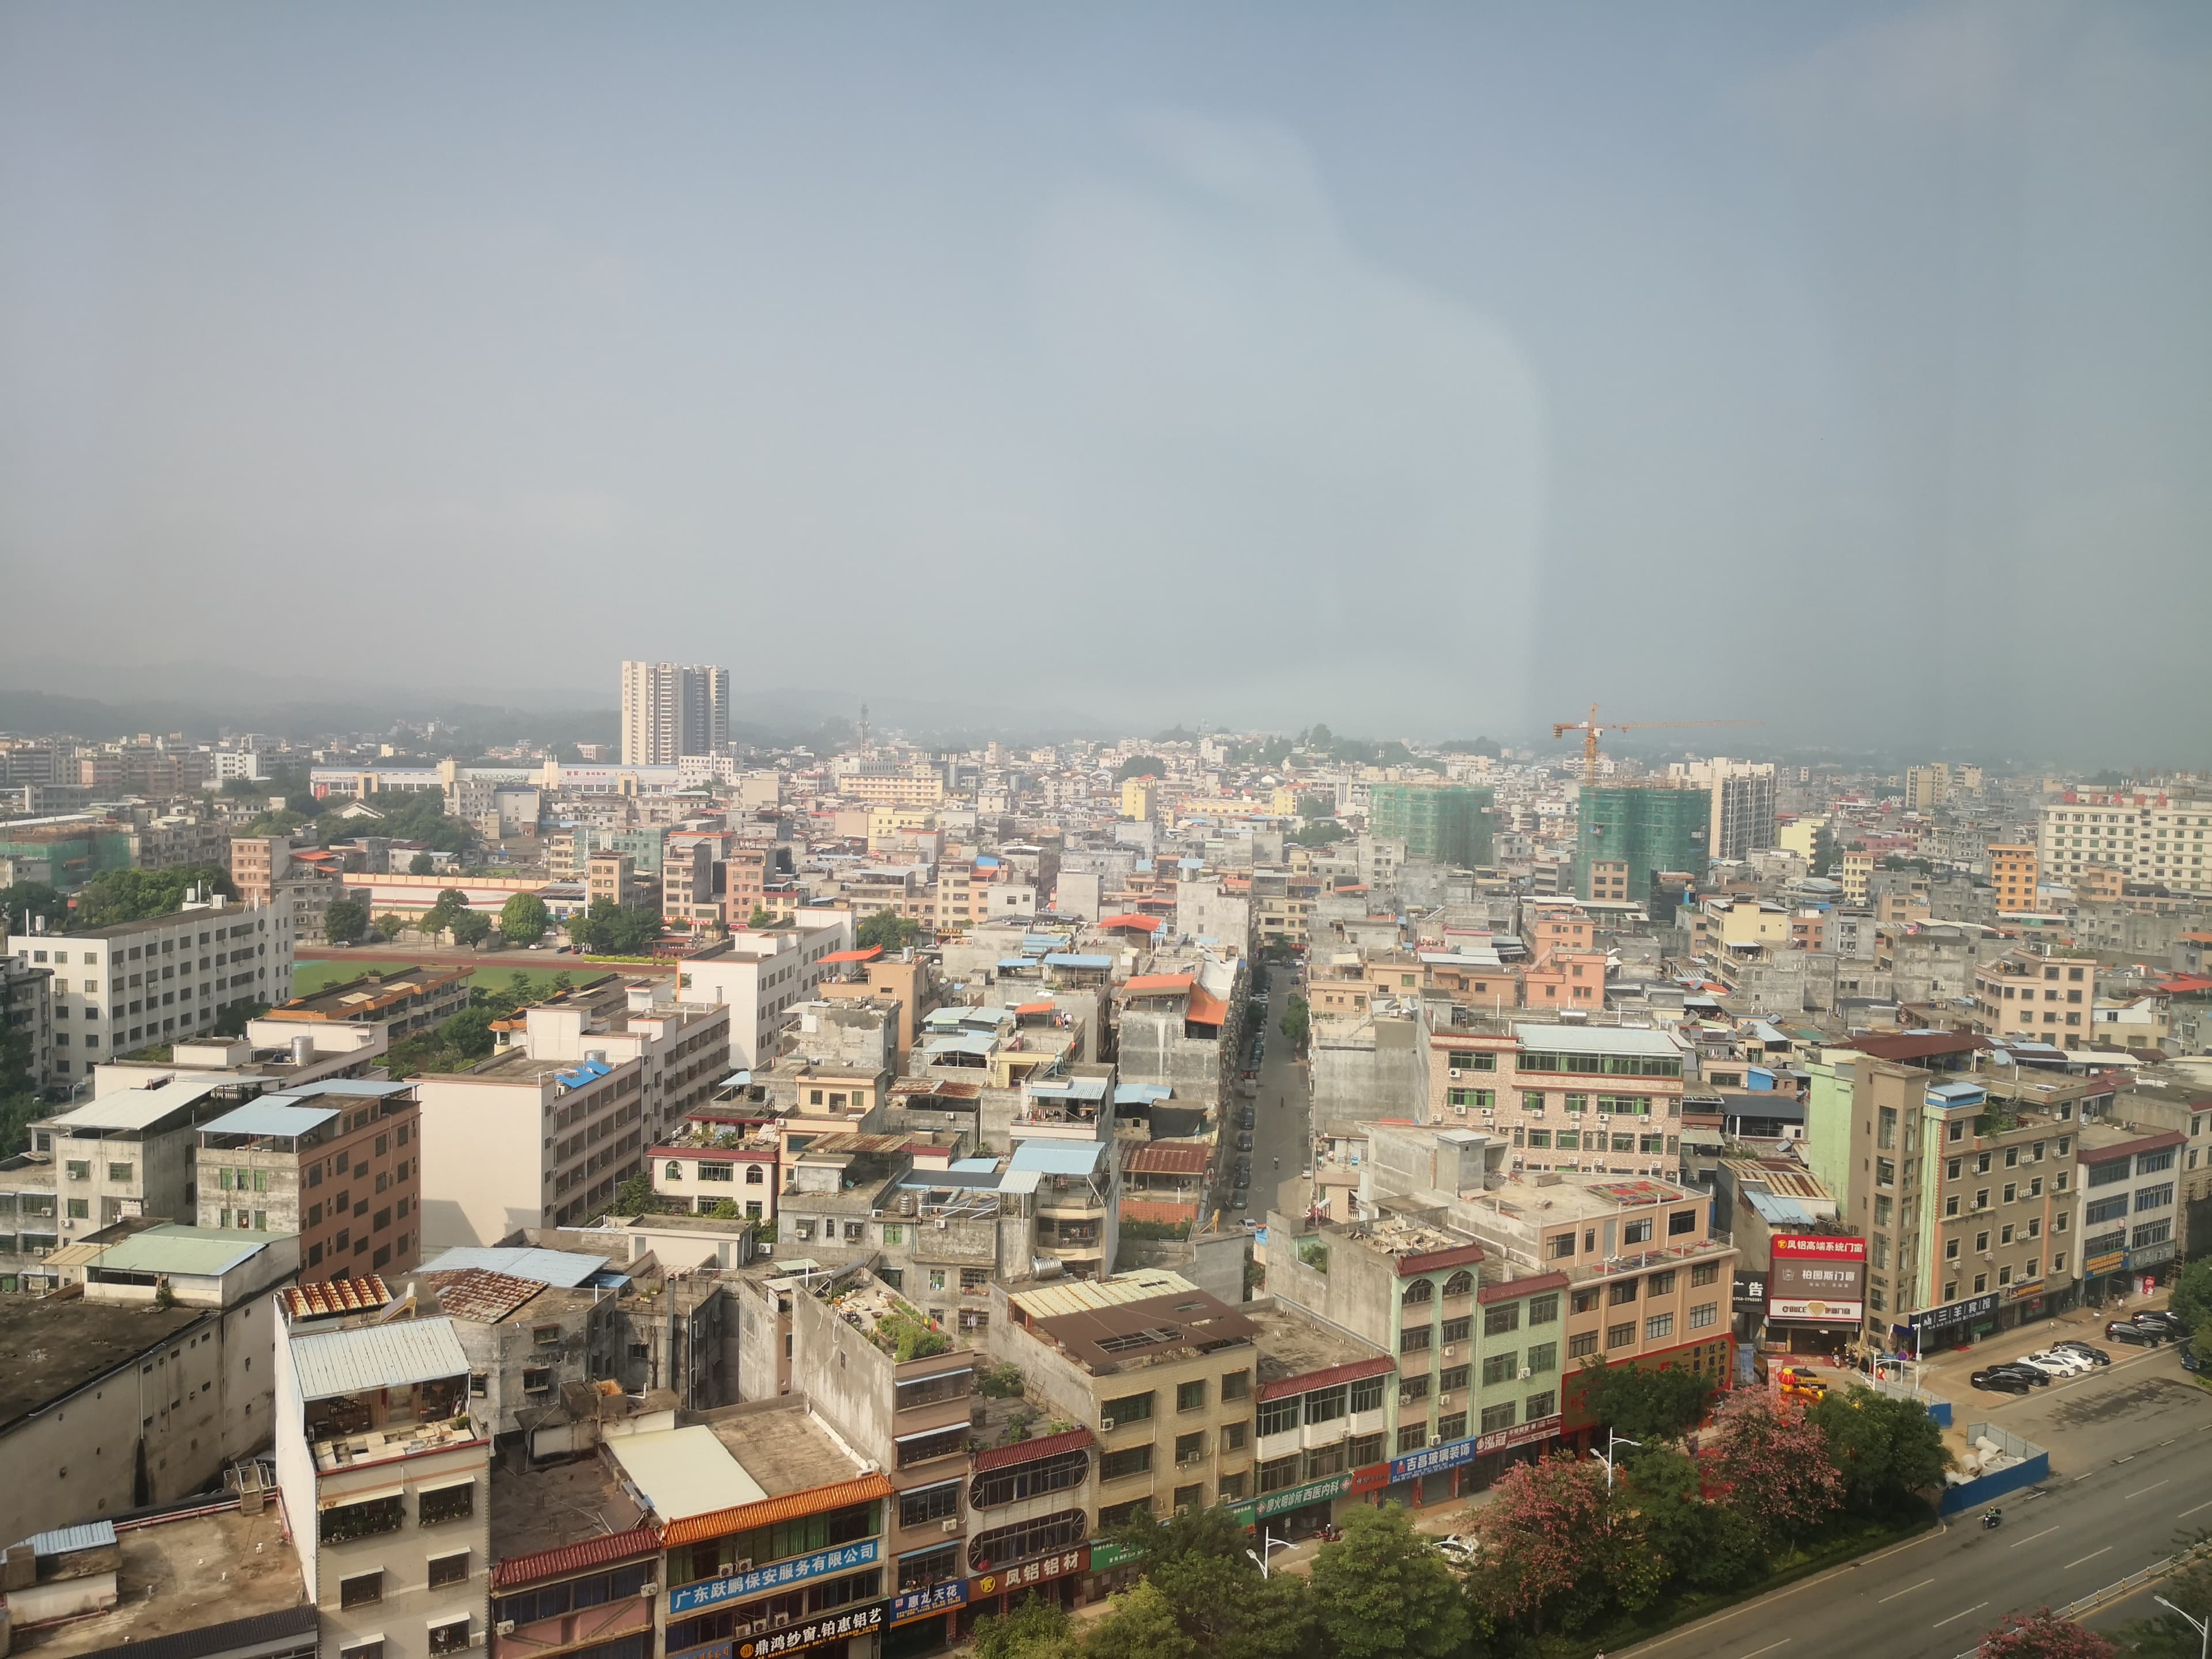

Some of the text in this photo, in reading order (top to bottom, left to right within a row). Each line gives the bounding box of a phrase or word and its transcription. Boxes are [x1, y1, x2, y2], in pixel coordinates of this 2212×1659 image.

[1484, 1431, 1507, 1450] 泓冠
[1407, 1443, 1470, 1471] 吉昌玻璃装饰
[1303, 1480, 1339, 1502] 西医内科
[676, 1543, 873, 1608] 广东跃鹏保安服务有限公司
